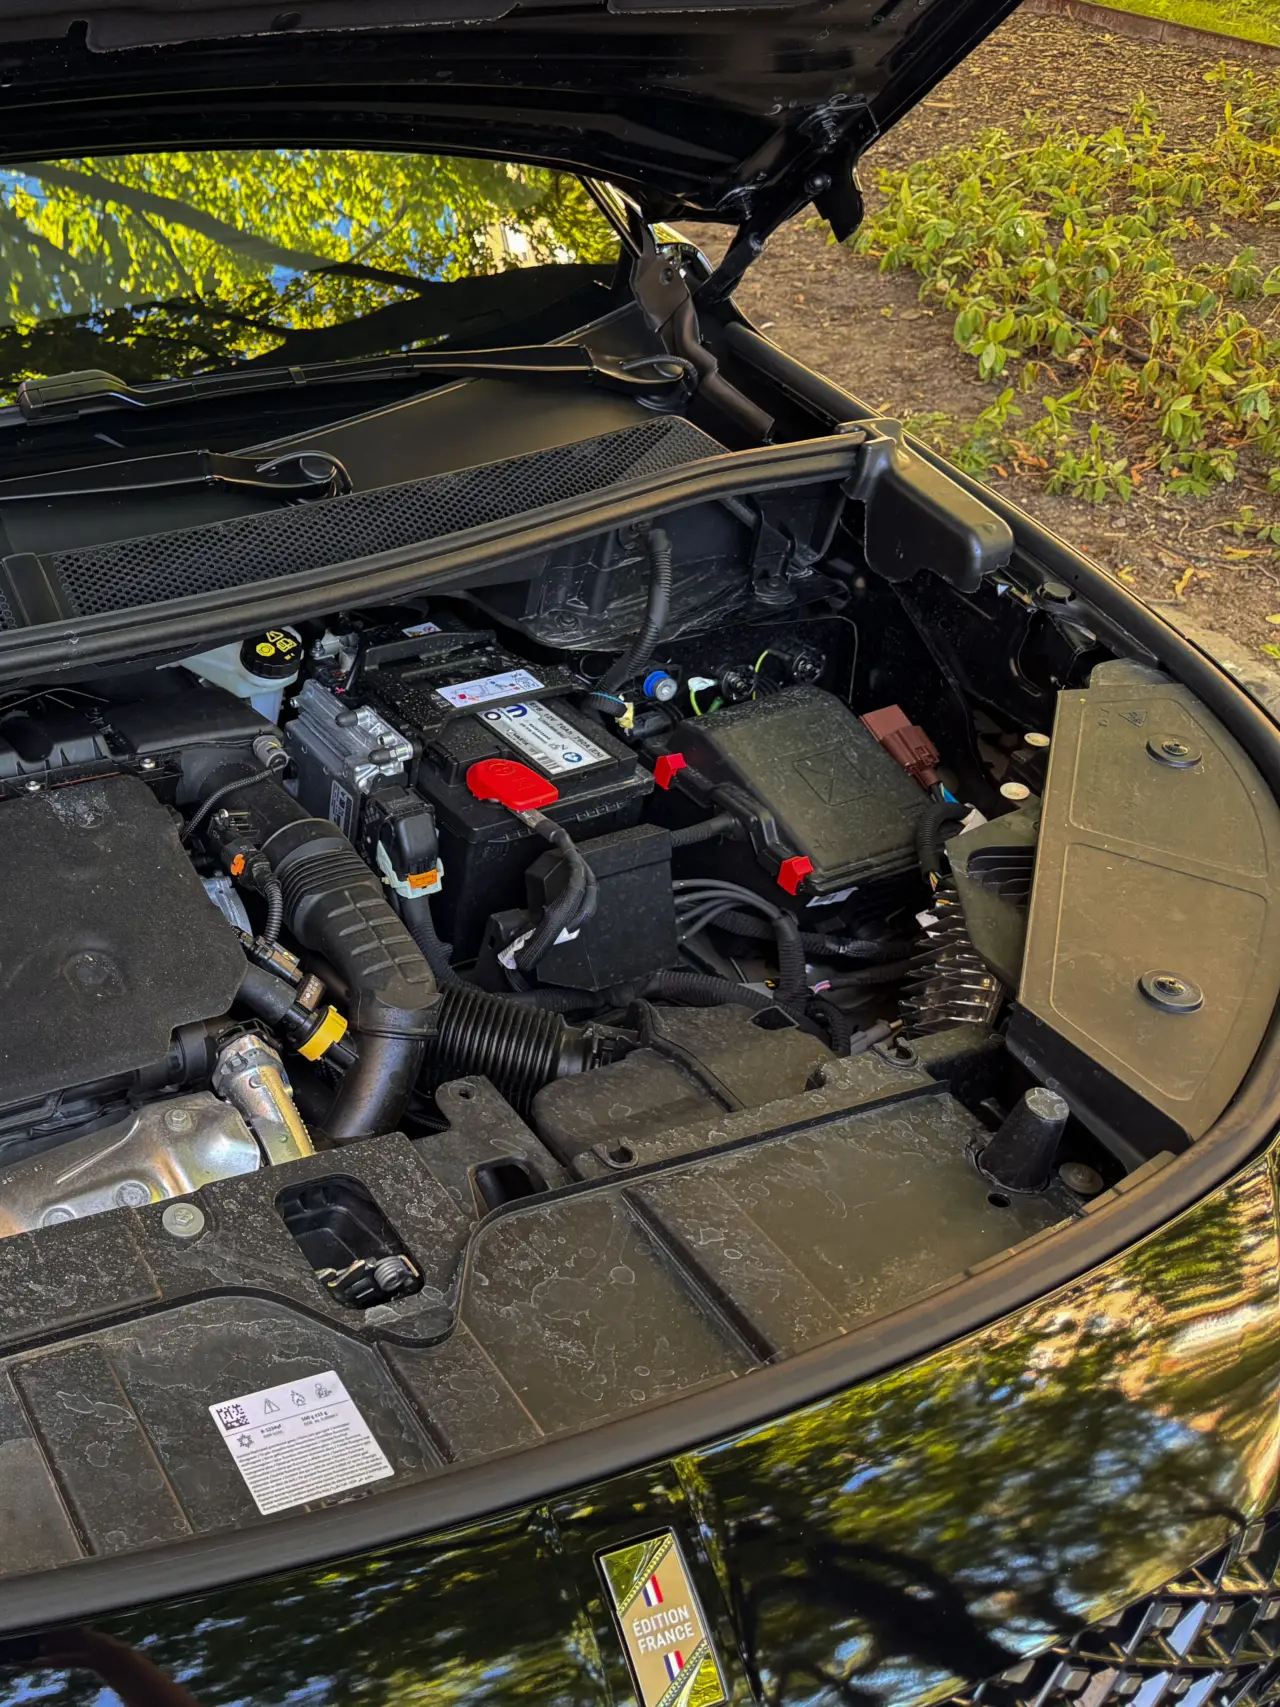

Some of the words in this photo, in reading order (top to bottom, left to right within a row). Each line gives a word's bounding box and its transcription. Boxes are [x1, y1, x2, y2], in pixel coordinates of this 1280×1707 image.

[529, 702, 544, 712] EFB
[544, 713, 557, 722] 12V
[557, 722, 573, 735] 70Ah
[588, 747, 605, 759] (EN)
[632, 1604, 690, 1638] ÉDITION
[637, 1621, 695, 1655] FRANCE
